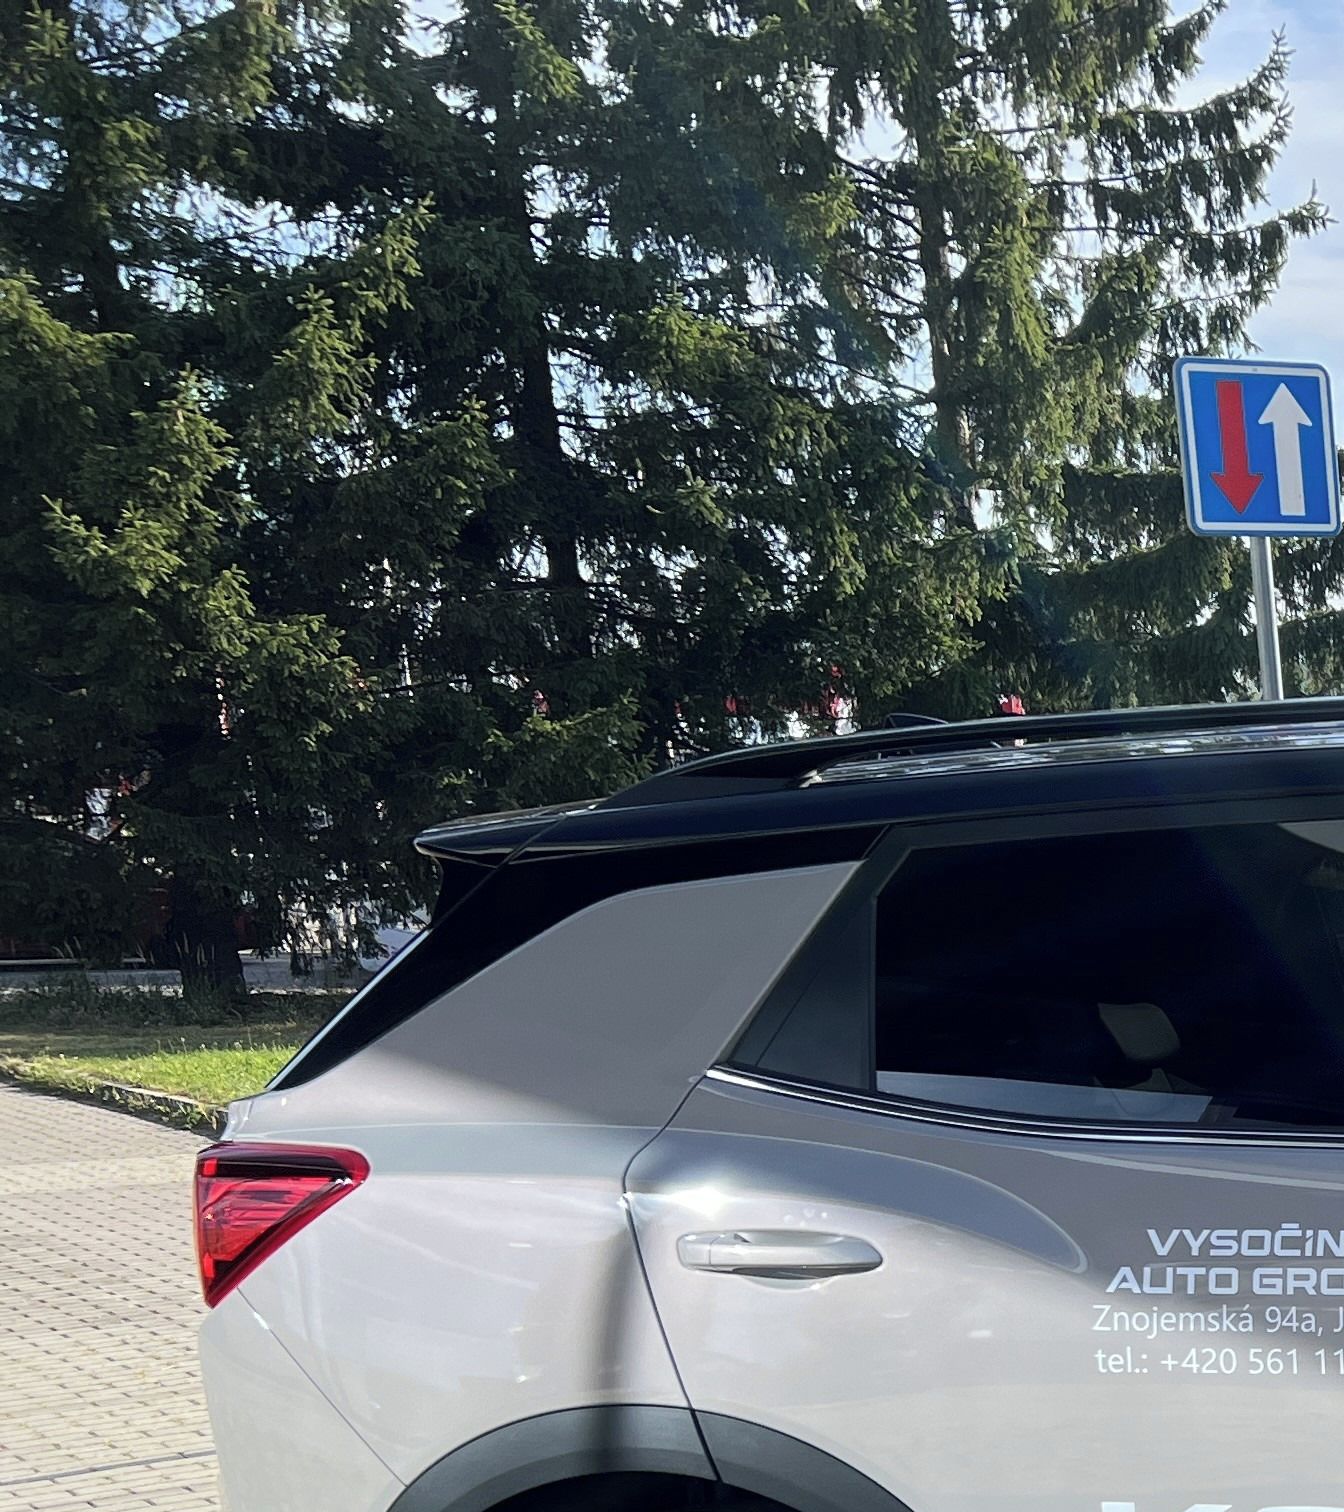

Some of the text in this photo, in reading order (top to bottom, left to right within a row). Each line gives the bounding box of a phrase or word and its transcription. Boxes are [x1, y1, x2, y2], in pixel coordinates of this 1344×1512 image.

[1105, 1266, 1239, 1296] AUTO
[1091, 1303, 1254, 1339] Znojemská
[1265, 1307, 1324, 1337] 94a,
[1094, 1346, 1149, 1375] tel.:
[1160, 1347, 1238, 1376] +420
[1247, 1348, 1300, 1376] 561
